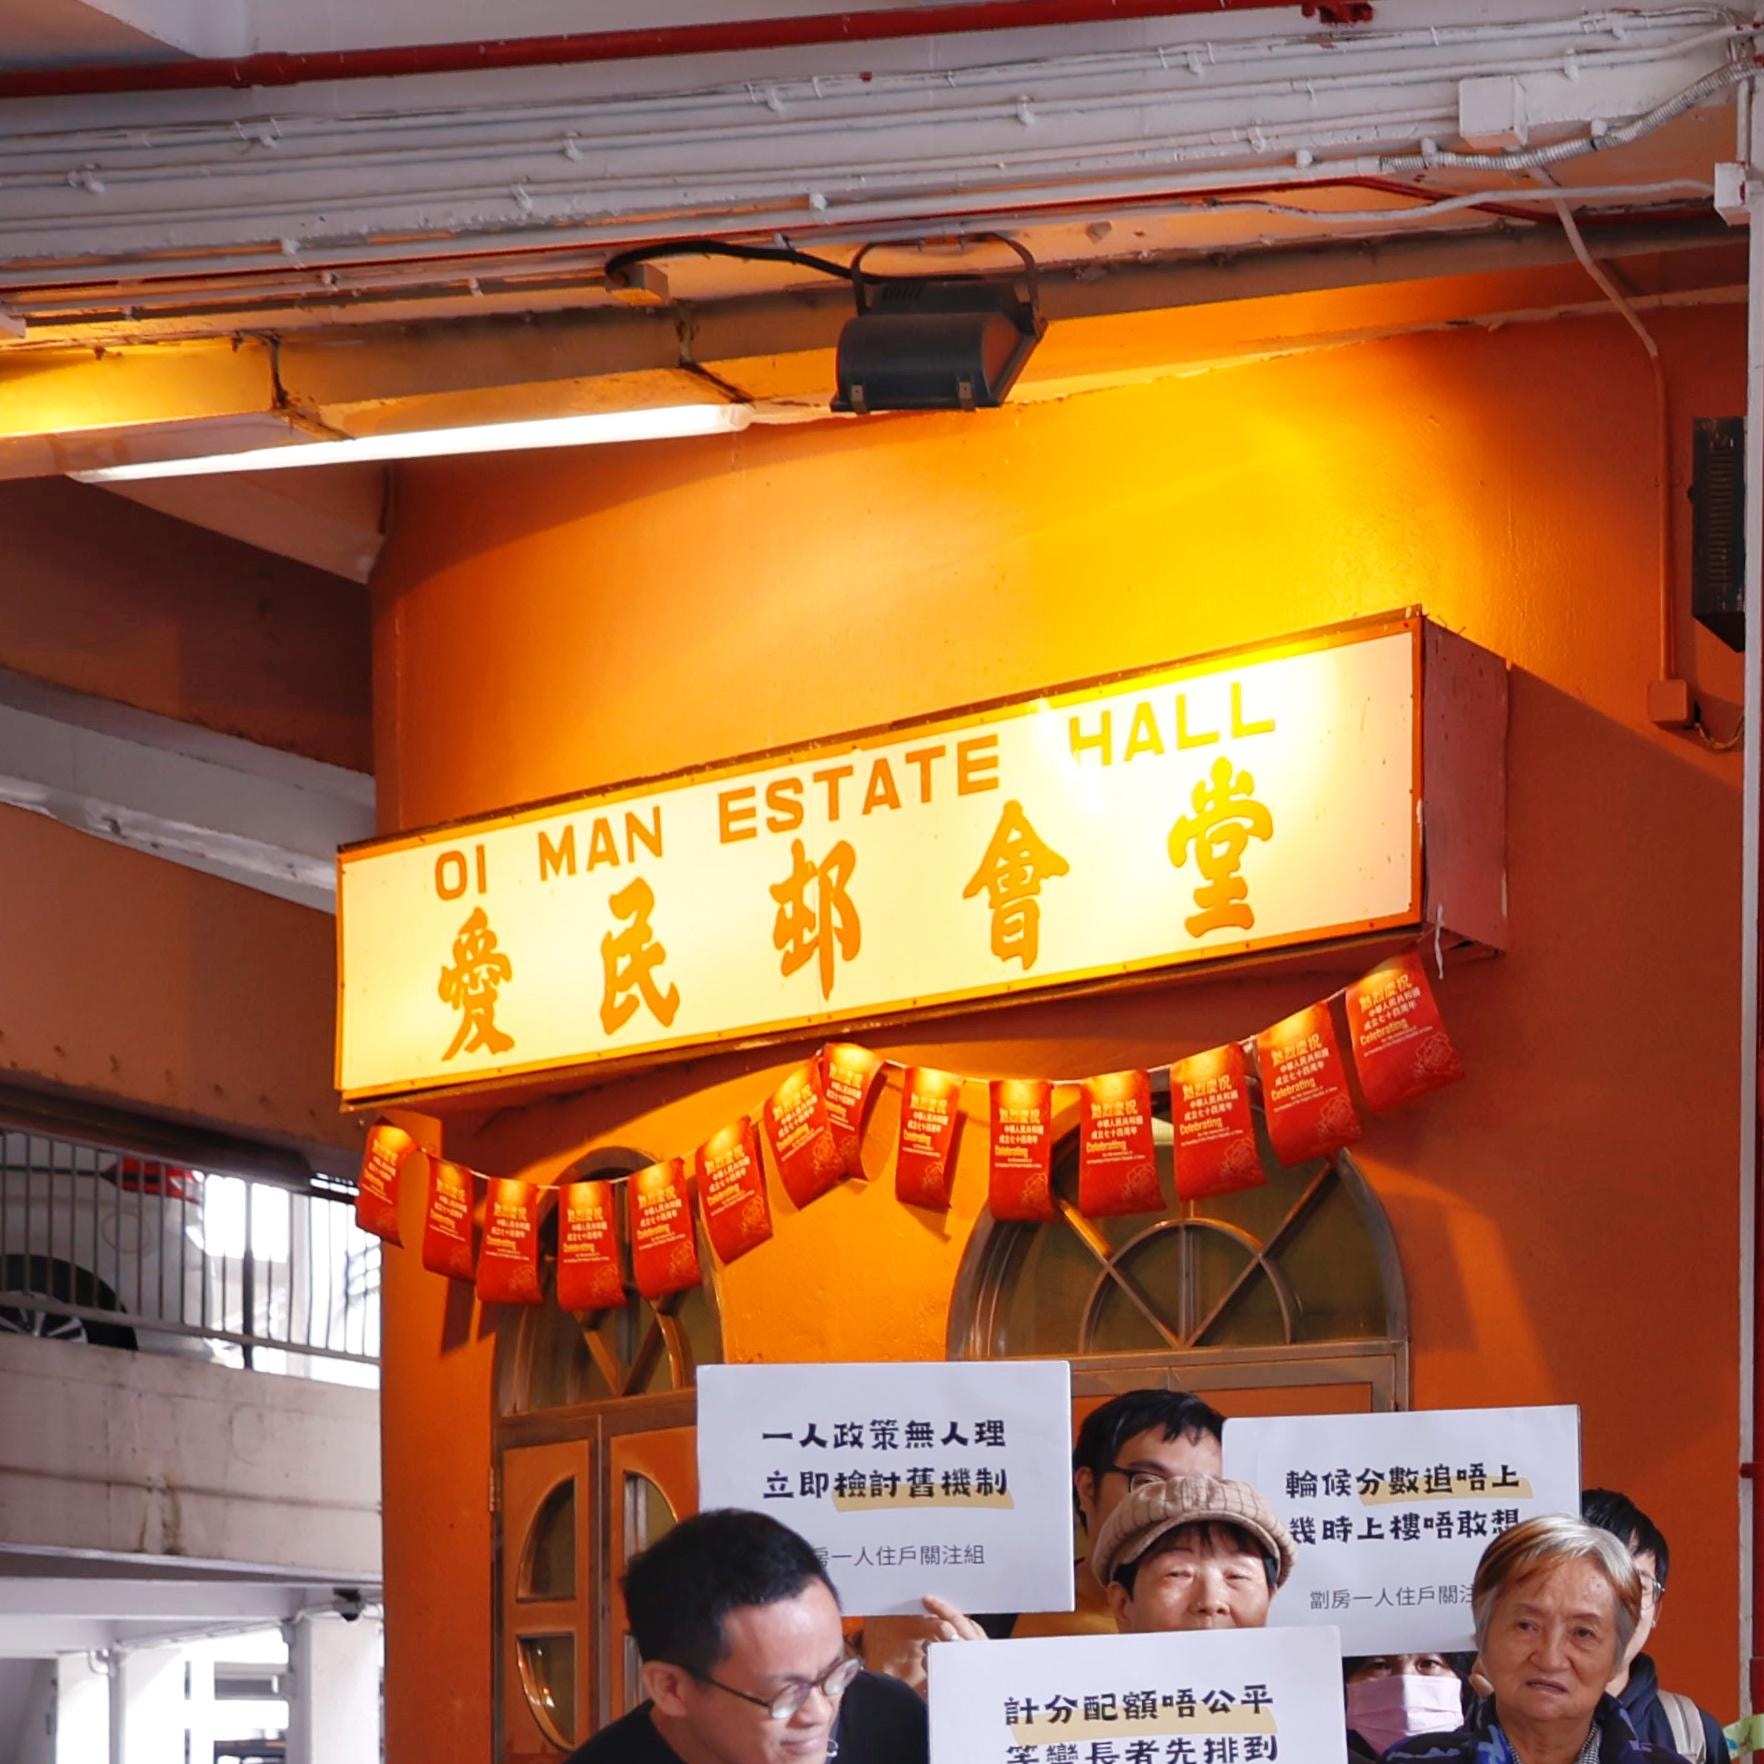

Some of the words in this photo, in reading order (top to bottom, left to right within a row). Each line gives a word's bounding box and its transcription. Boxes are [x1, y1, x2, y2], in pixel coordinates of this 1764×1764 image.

[435, 846, 486, 901] OI
[539, 806, 663, 883] MAN
[719, 734, 1000, 844] ESTATE
[1068, 681, 1275, 767] HALL
[437, 757, 1275, 1064] 愛民邨會堂
[761, 1419, 1006, 1450] 一人政策無人理
[762, 1467, 1008, 1500] 立即檢討舊機制
[1285, 1463, 1520, 1499] 輪候分數追唔上
[1004, 1684, 1273, 1725] 計分配額唔公平
